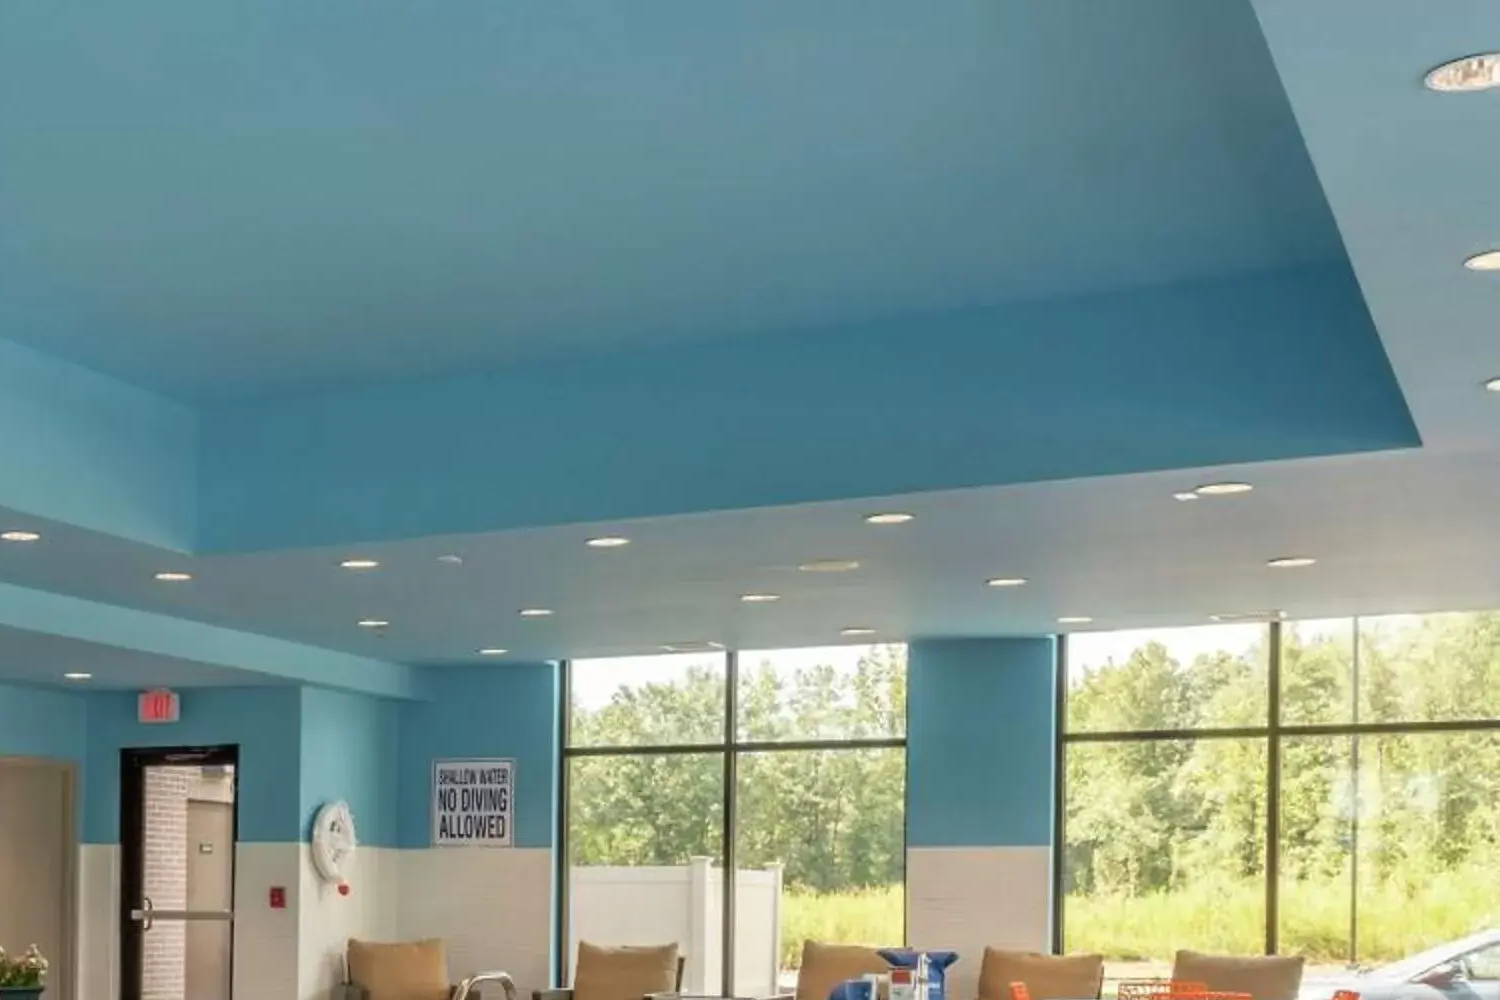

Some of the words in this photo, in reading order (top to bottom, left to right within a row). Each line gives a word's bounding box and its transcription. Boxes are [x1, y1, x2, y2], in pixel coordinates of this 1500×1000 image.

[439, 769, 477, 785] SHALLOW
[479, 768, 508, 785] WATER
[438, 788, 457, 812] NO
[461, 788, 507, 812] DIVING
[439, 815, 505, 838] ALLOWED
